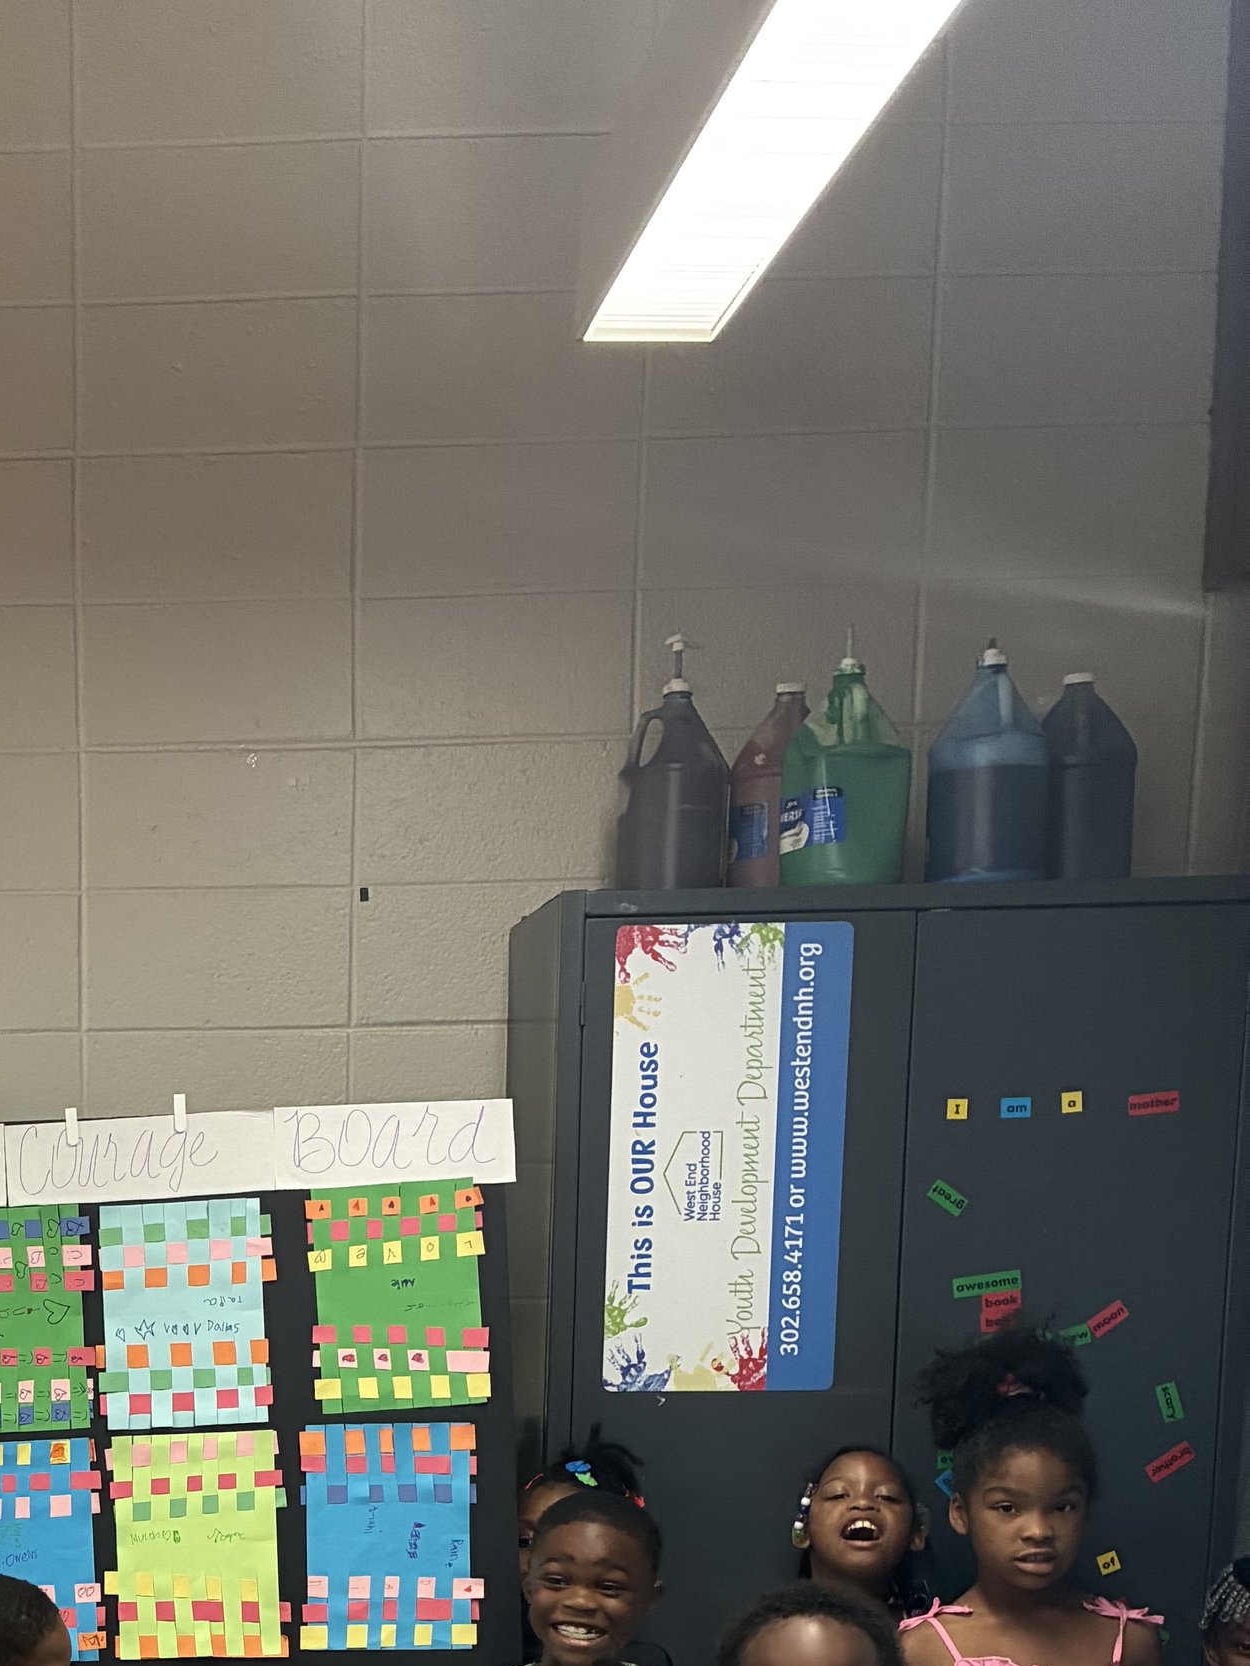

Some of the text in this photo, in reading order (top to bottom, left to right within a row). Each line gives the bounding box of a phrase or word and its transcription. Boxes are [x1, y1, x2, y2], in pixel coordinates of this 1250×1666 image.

[954, 1104, 961, 1115] I
[1006, 1104, 1028, 1114] am
[1067, 1099, 1077, 1109] a
[726, 957, 774, 1336] Youth Development Department
[779, 942, 823, 1356] 302.658.4171 or www.westendnh.org
[627, 1041, 659, 1295] This is OUR House
[696, 1130, 712, 1222] Neighborhood
[683, 1162, 697, 1222] West End
[709, 1181, 722, 1222] House
[932, 1184, 966, 1211] great
[955, 1275, 1019, 1293] awesome
[1092, 1305, 1125, 1333] moon
[1161, 1386, 1176, 1420] scary
